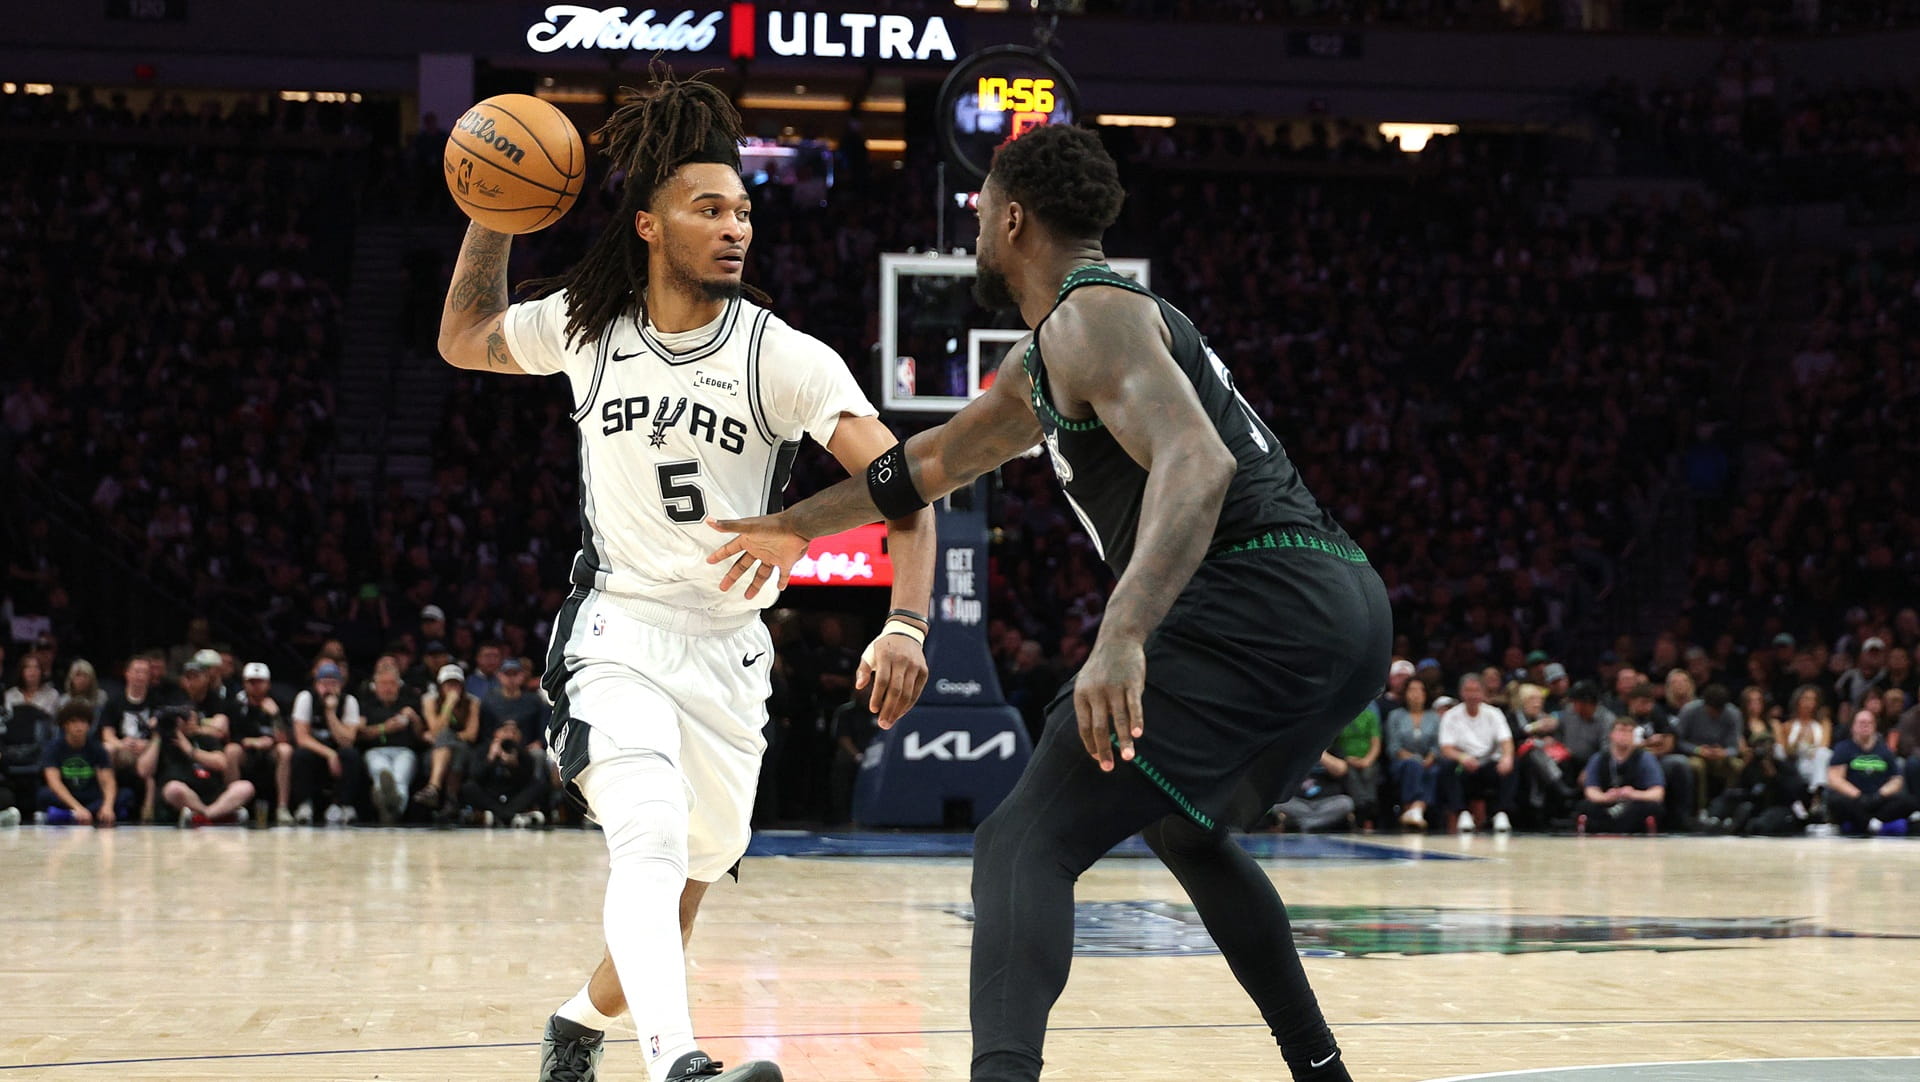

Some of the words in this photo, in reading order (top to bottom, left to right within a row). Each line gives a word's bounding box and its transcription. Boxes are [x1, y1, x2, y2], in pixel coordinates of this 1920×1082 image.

[526, 4, 723, 53] Michelob
[768, 10, 957, 60] ULTRA
[978, 77, 1054, 112] 10:56
[457, 110, 526, 166] Wilson
[700, 376, 733, 390] LEDGER
[602, 395, 748, 455] SPURS
[655, 458, 708, 525] 5
[946, 548, 975, 571] GET
[946, 571, 975, 597] THE
[936, 678, 982, 697] Google
